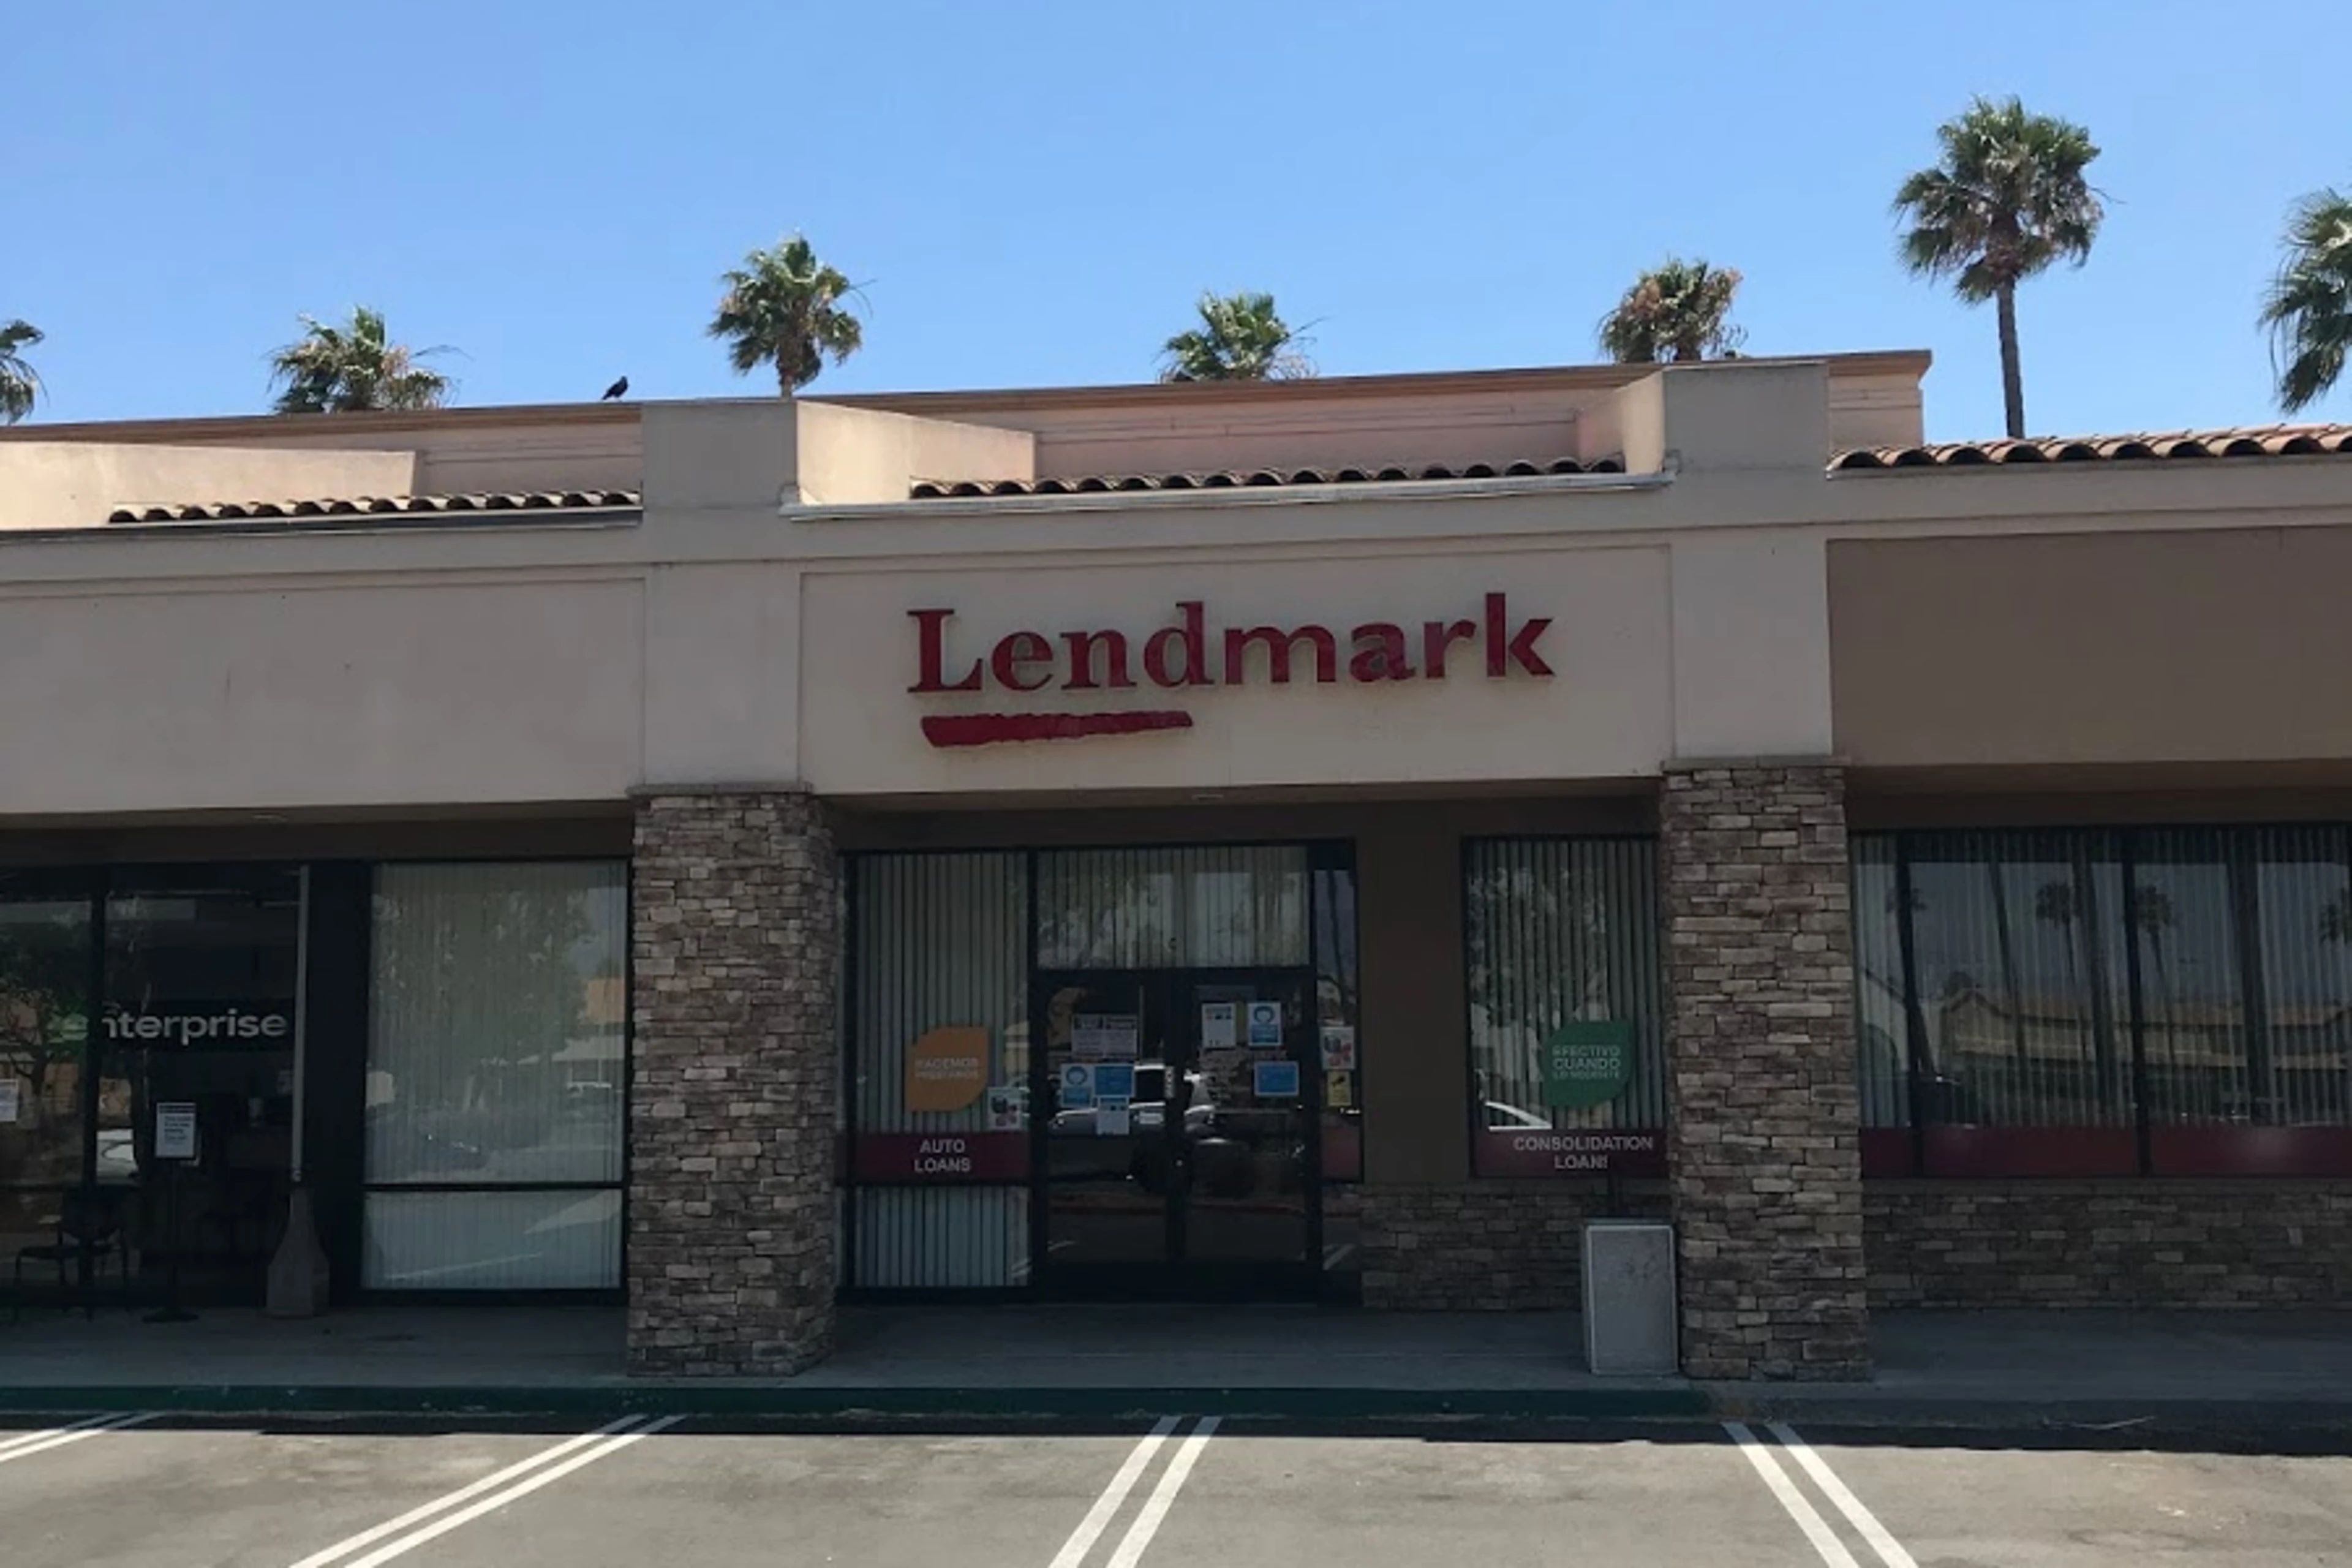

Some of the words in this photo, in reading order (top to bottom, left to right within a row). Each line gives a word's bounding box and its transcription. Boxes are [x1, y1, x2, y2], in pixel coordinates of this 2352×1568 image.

[907, 592, 1556, 693] Lendmark
[1551, 1044, 1621, 1057] EFECTIVO
[1552, 1058, 1621, 1070] CUANDO
[919, 1138, 966, 1153] AUTO
[1512, 1136, 1654, 1151] CONSOLIDATION
[914, 1157, 971, 1173] LOANS
